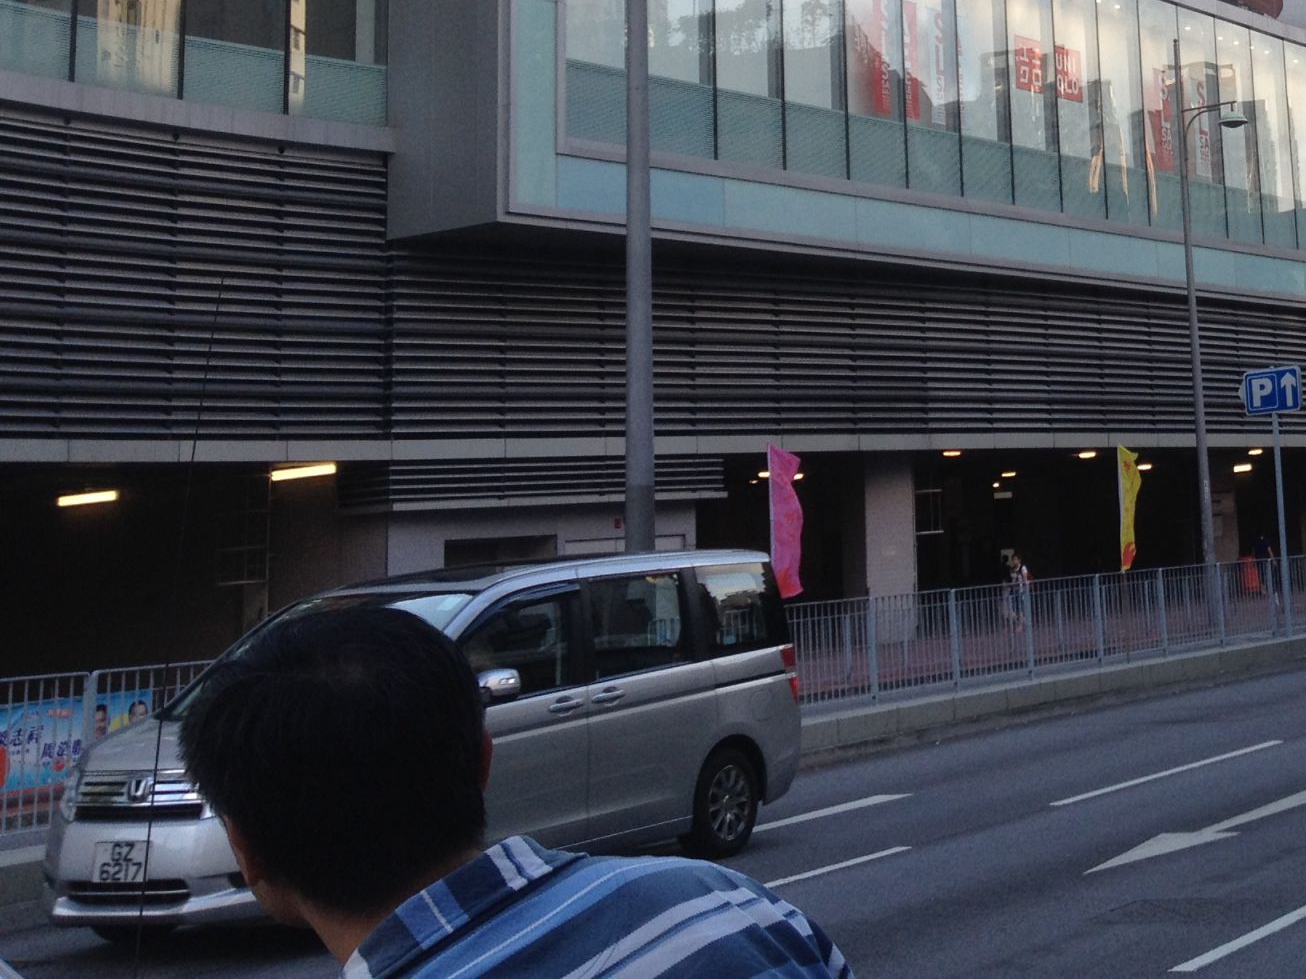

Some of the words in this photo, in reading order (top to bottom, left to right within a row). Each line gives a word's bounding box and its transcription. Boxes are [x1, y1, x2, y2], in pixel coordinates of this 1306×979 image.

[1252, 377, 1273, 408] P
[110, 843, 135, 863] GZ
[100, 863, 143, 881] 6217
